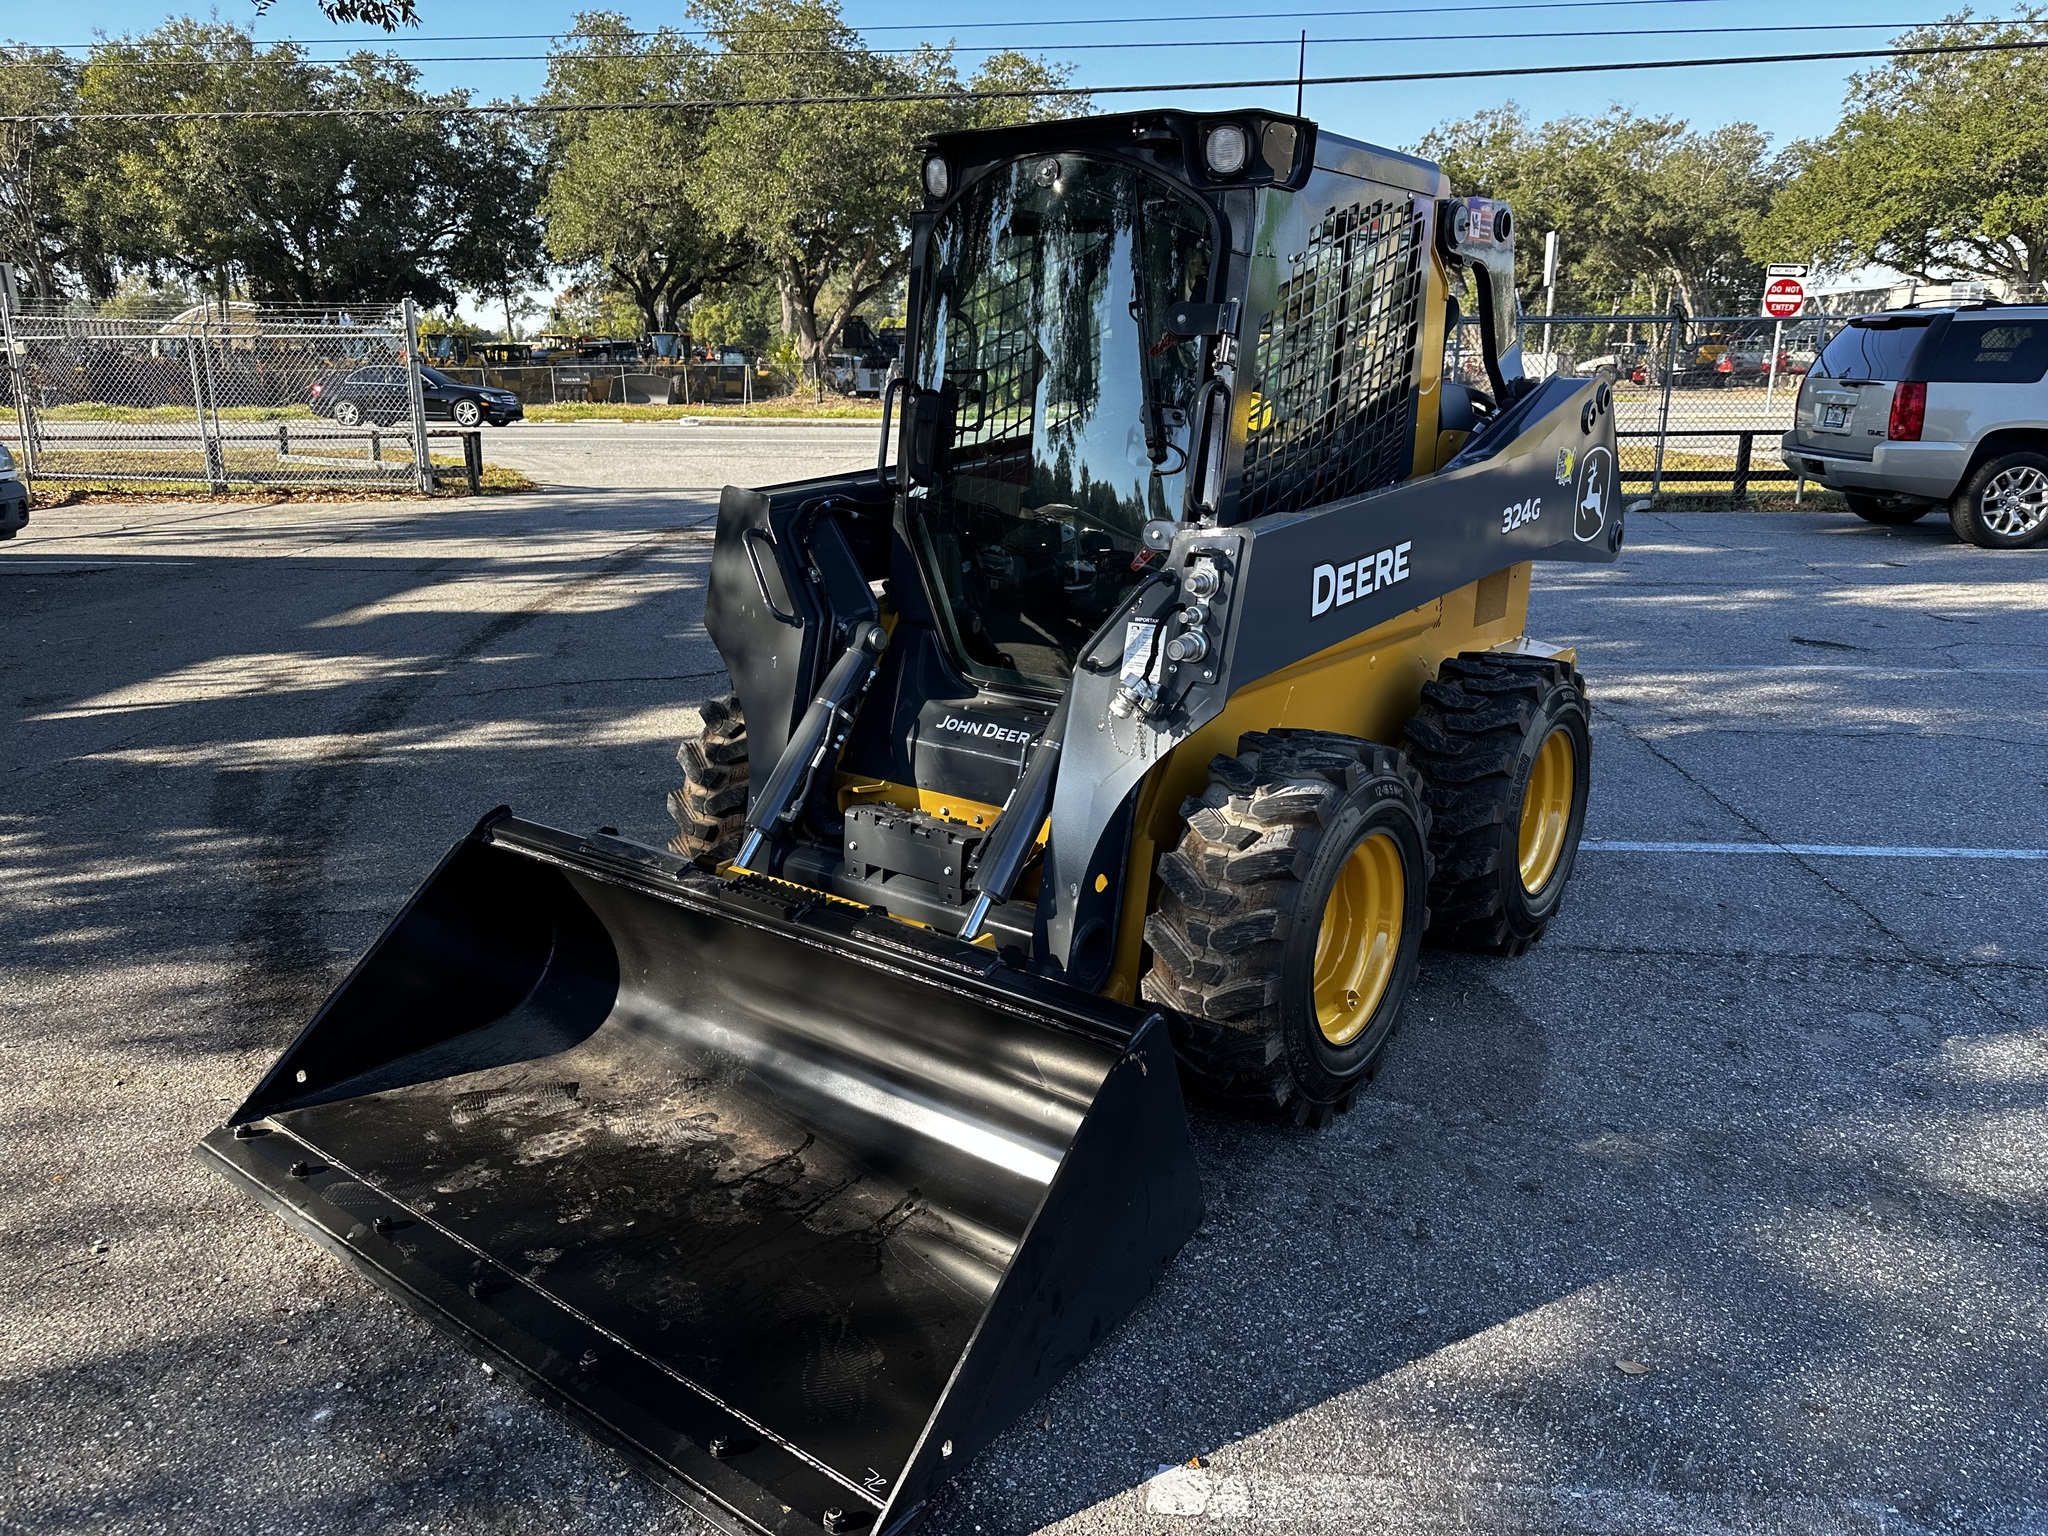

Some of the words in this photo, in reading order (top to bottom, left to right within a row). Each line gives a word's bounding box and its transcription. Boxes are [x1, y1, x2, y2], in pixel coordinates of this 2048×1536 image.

[1868, 429, 1886, 437] GMC
[1501, 497, 1541, 534] 324G
[1311, 540, 1412, 618] DEERE
[1134, 616, 1160, 624] IMPORTAN
[936, 715, 982, 735] JOHN
[1509, 752, 1531, 808] CAMSO
